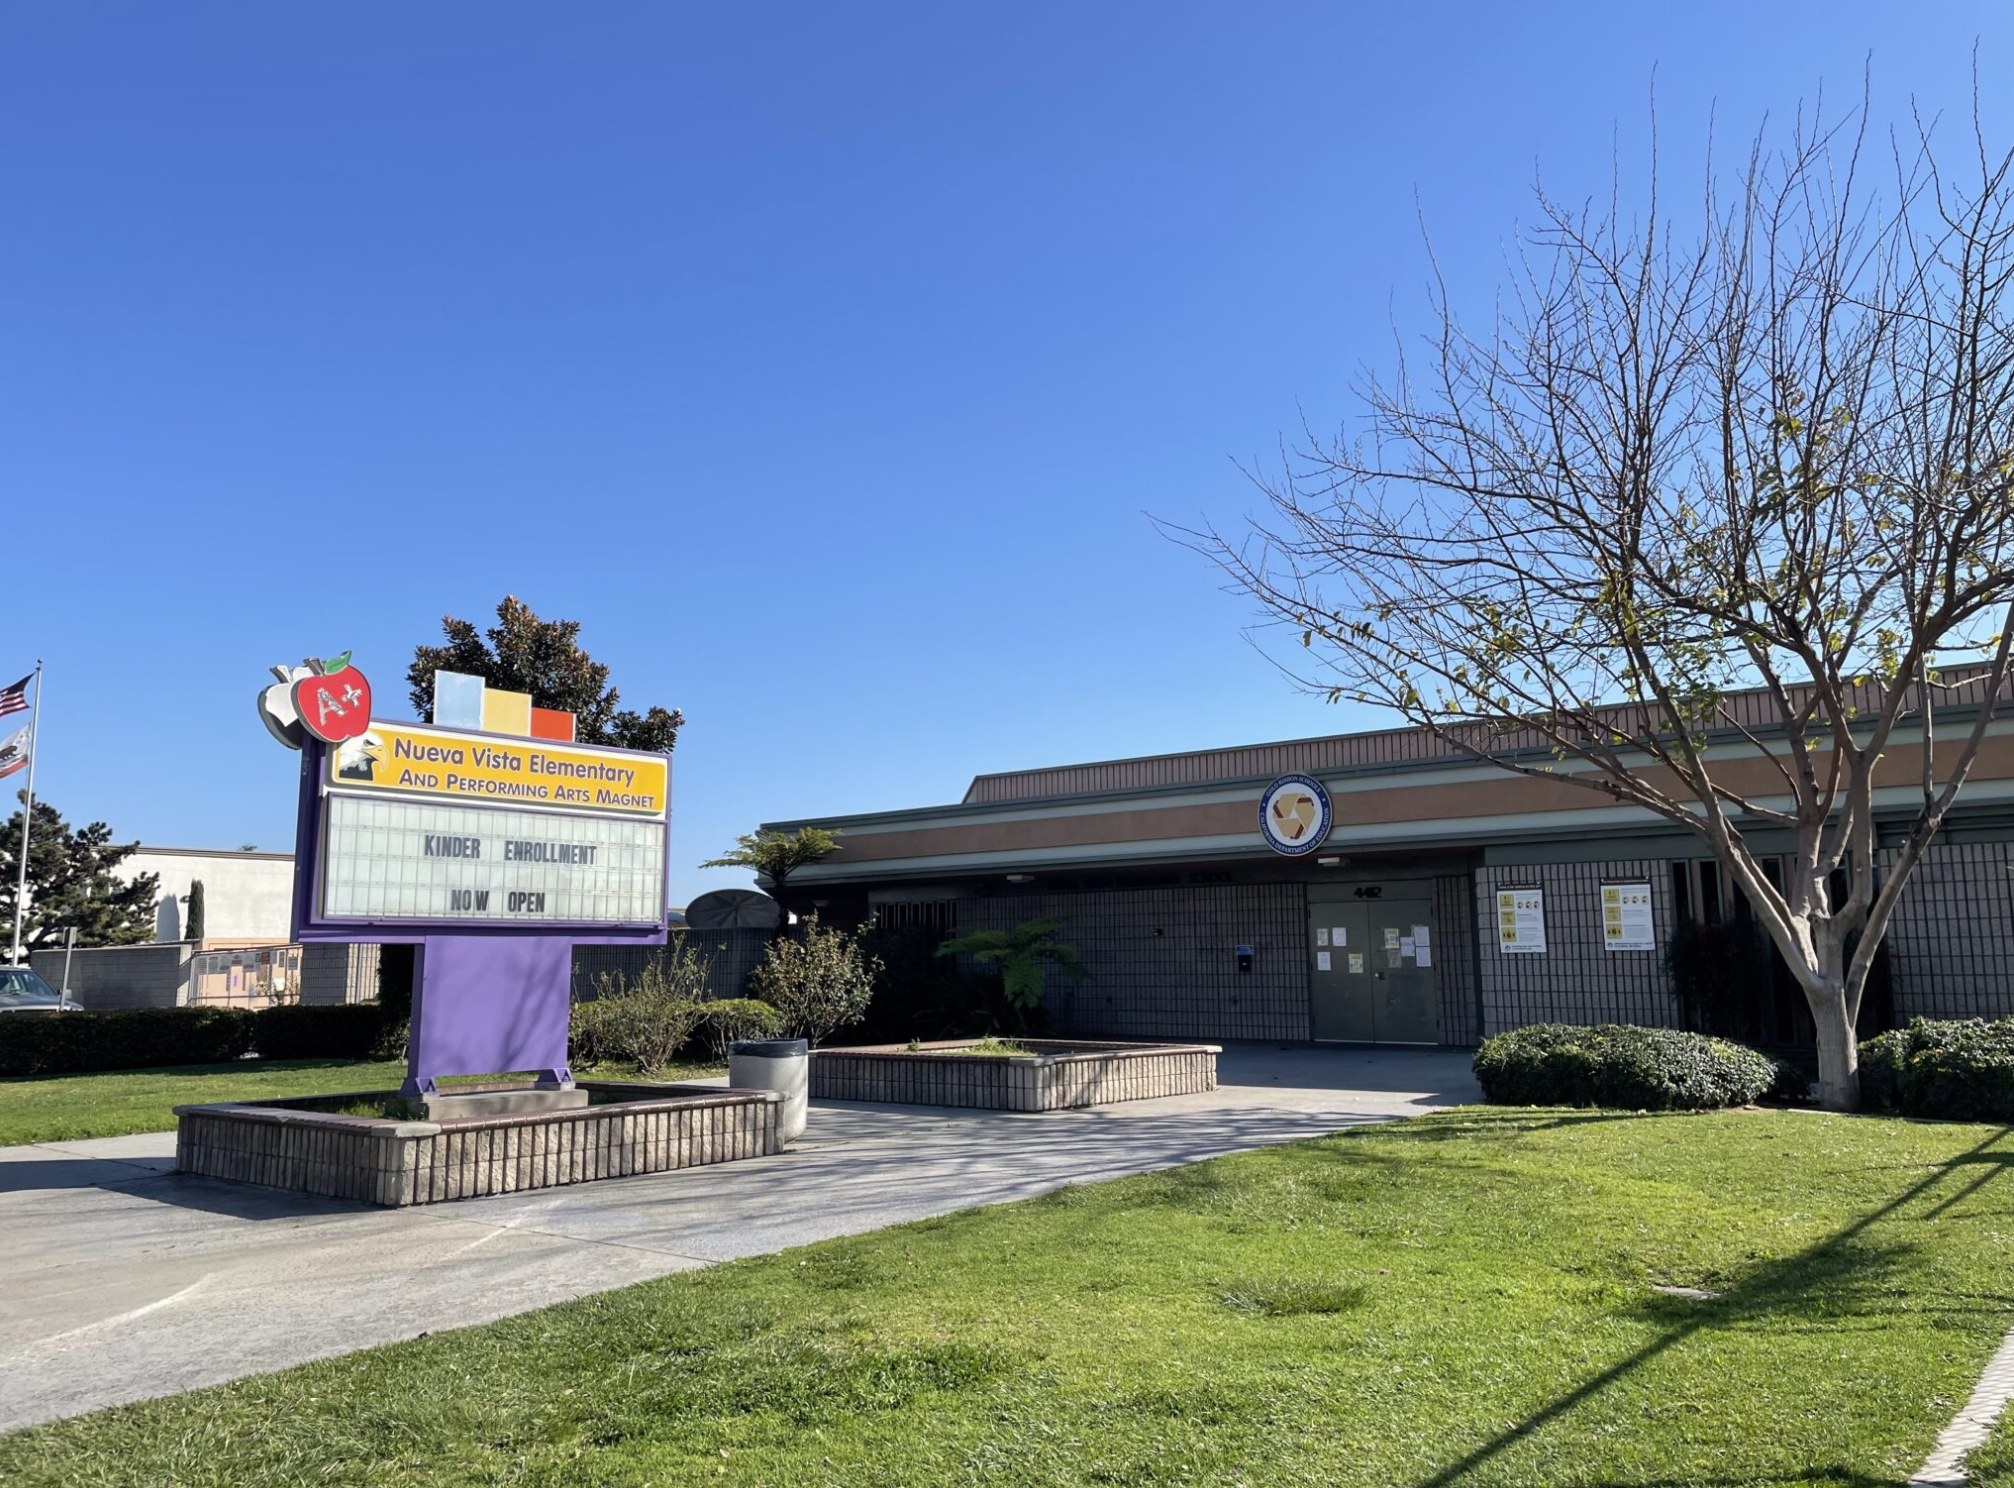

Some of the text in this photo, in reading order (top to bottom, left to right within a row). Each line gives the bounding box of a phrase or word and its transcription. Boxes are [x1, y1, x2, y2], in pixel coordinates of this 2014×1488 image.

[317, 683, 362, 726] A+
[394, 737, 635, 788] Nueva Vista Elementary
[1299, 776, 1321, 793] SCHOOLS
[1260, 807, 1329, 853] CALIFORNIA DEPARTMENT OF EDUCATION
[424, 834, 597, 865] KINDER ENROLLMENT
[451, 889, 545, 913] NOW OPEN
